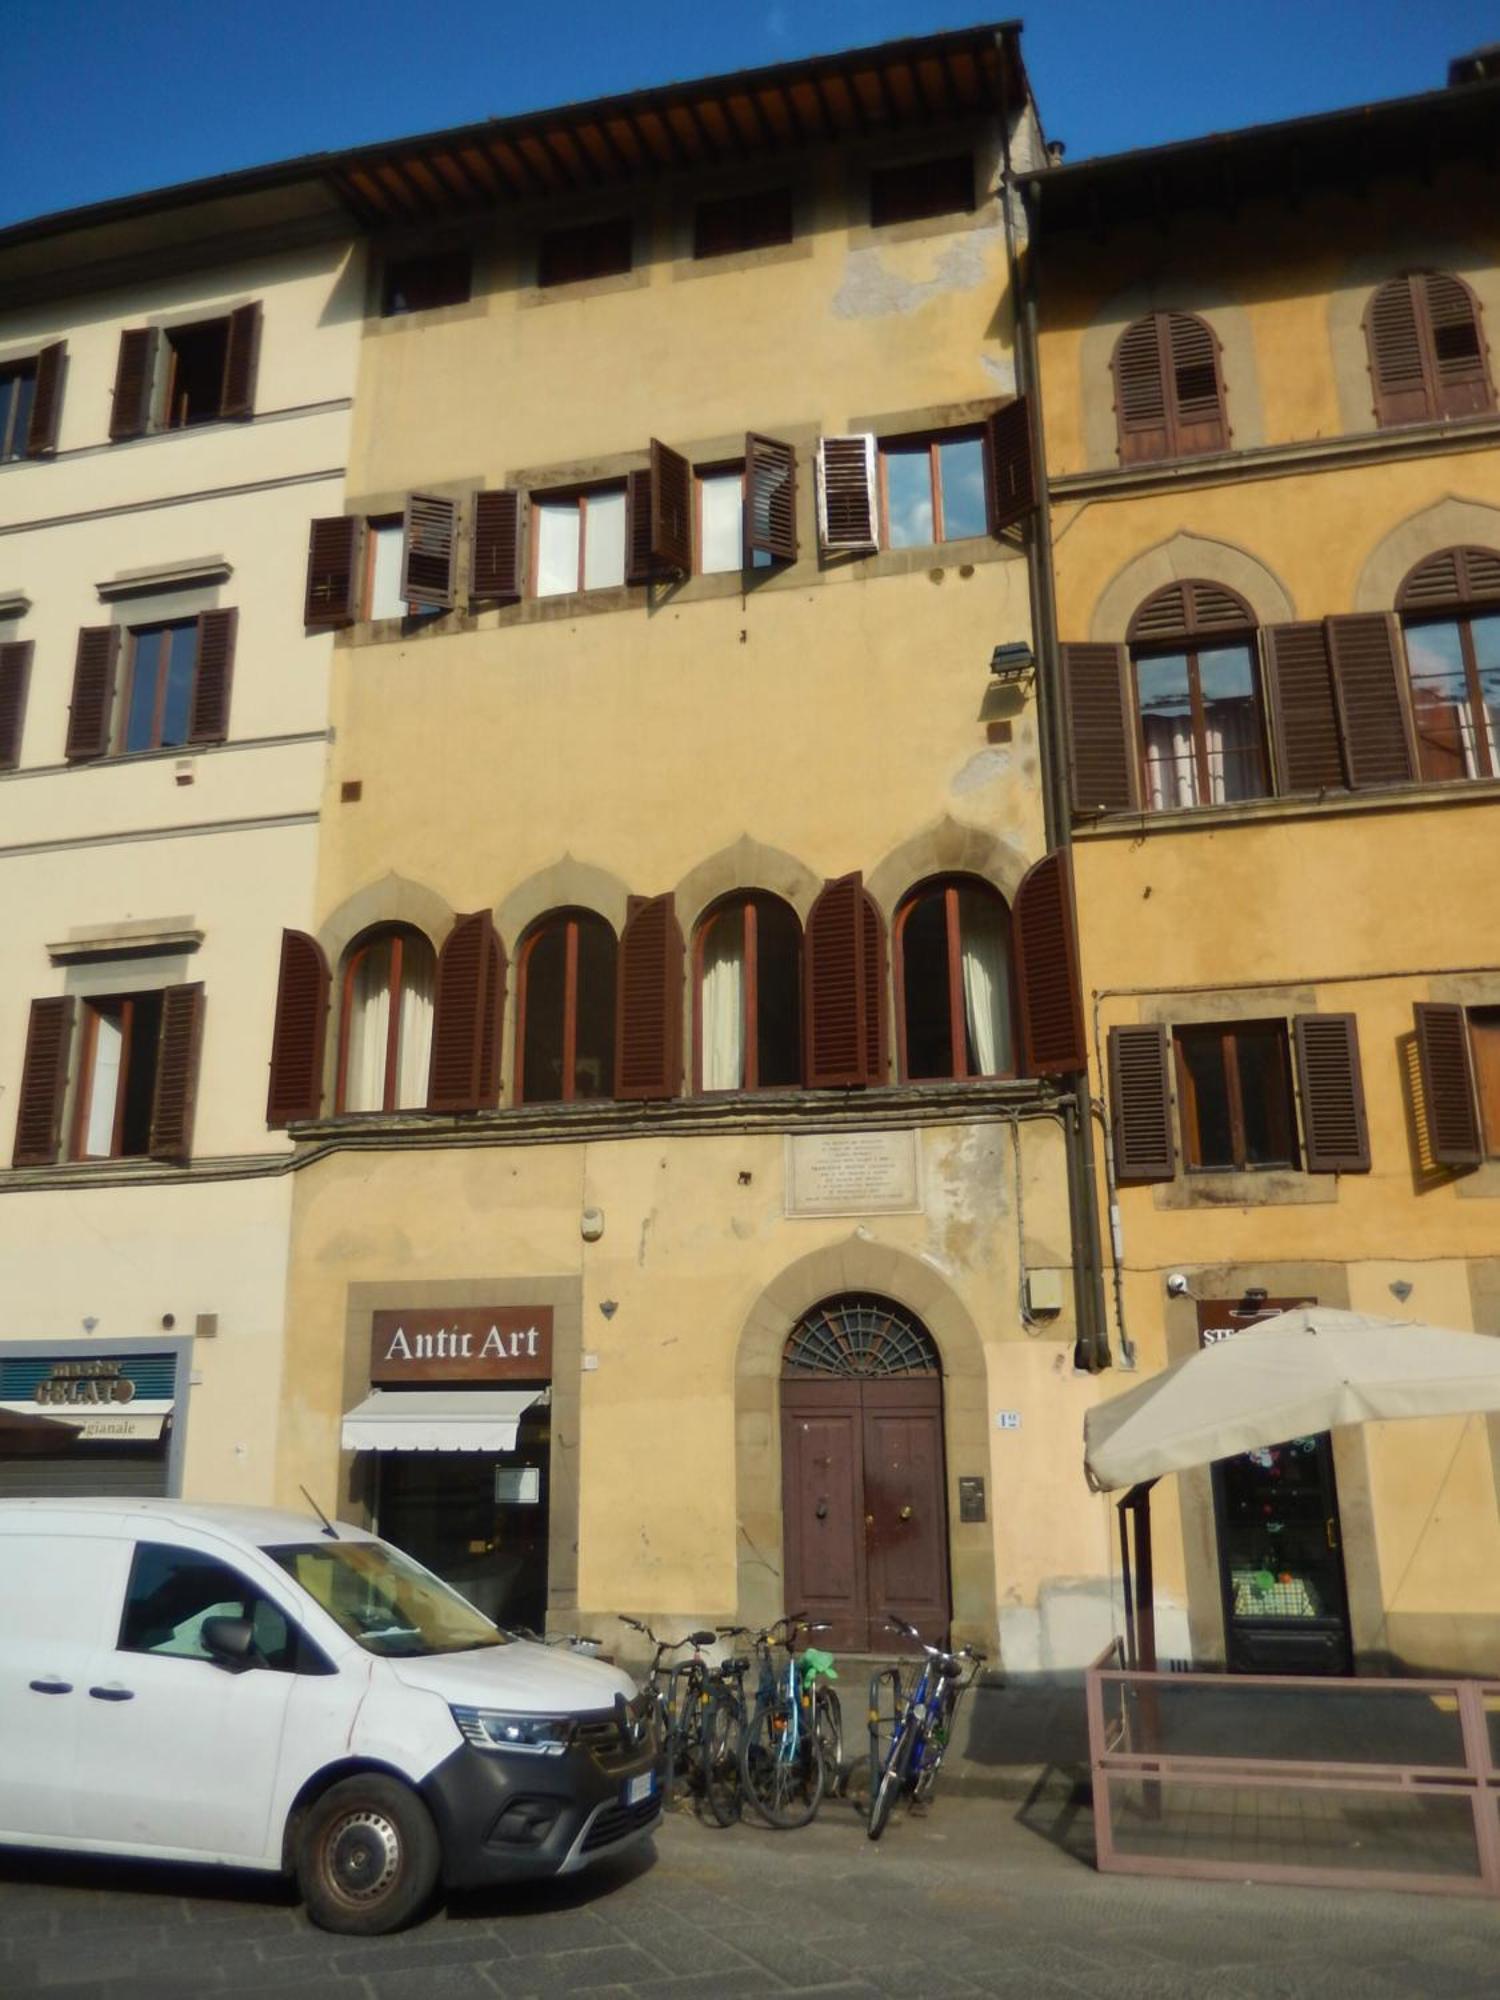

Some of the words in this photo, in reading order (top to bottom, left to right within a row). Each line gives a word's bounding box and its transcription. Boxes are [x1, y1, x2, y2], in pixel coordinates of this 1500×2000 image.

[384, 1325, 472, 1360] Antic
[479, 1325, 539, 1358] Art
[36, 1379, 135, 1405] GELATO
